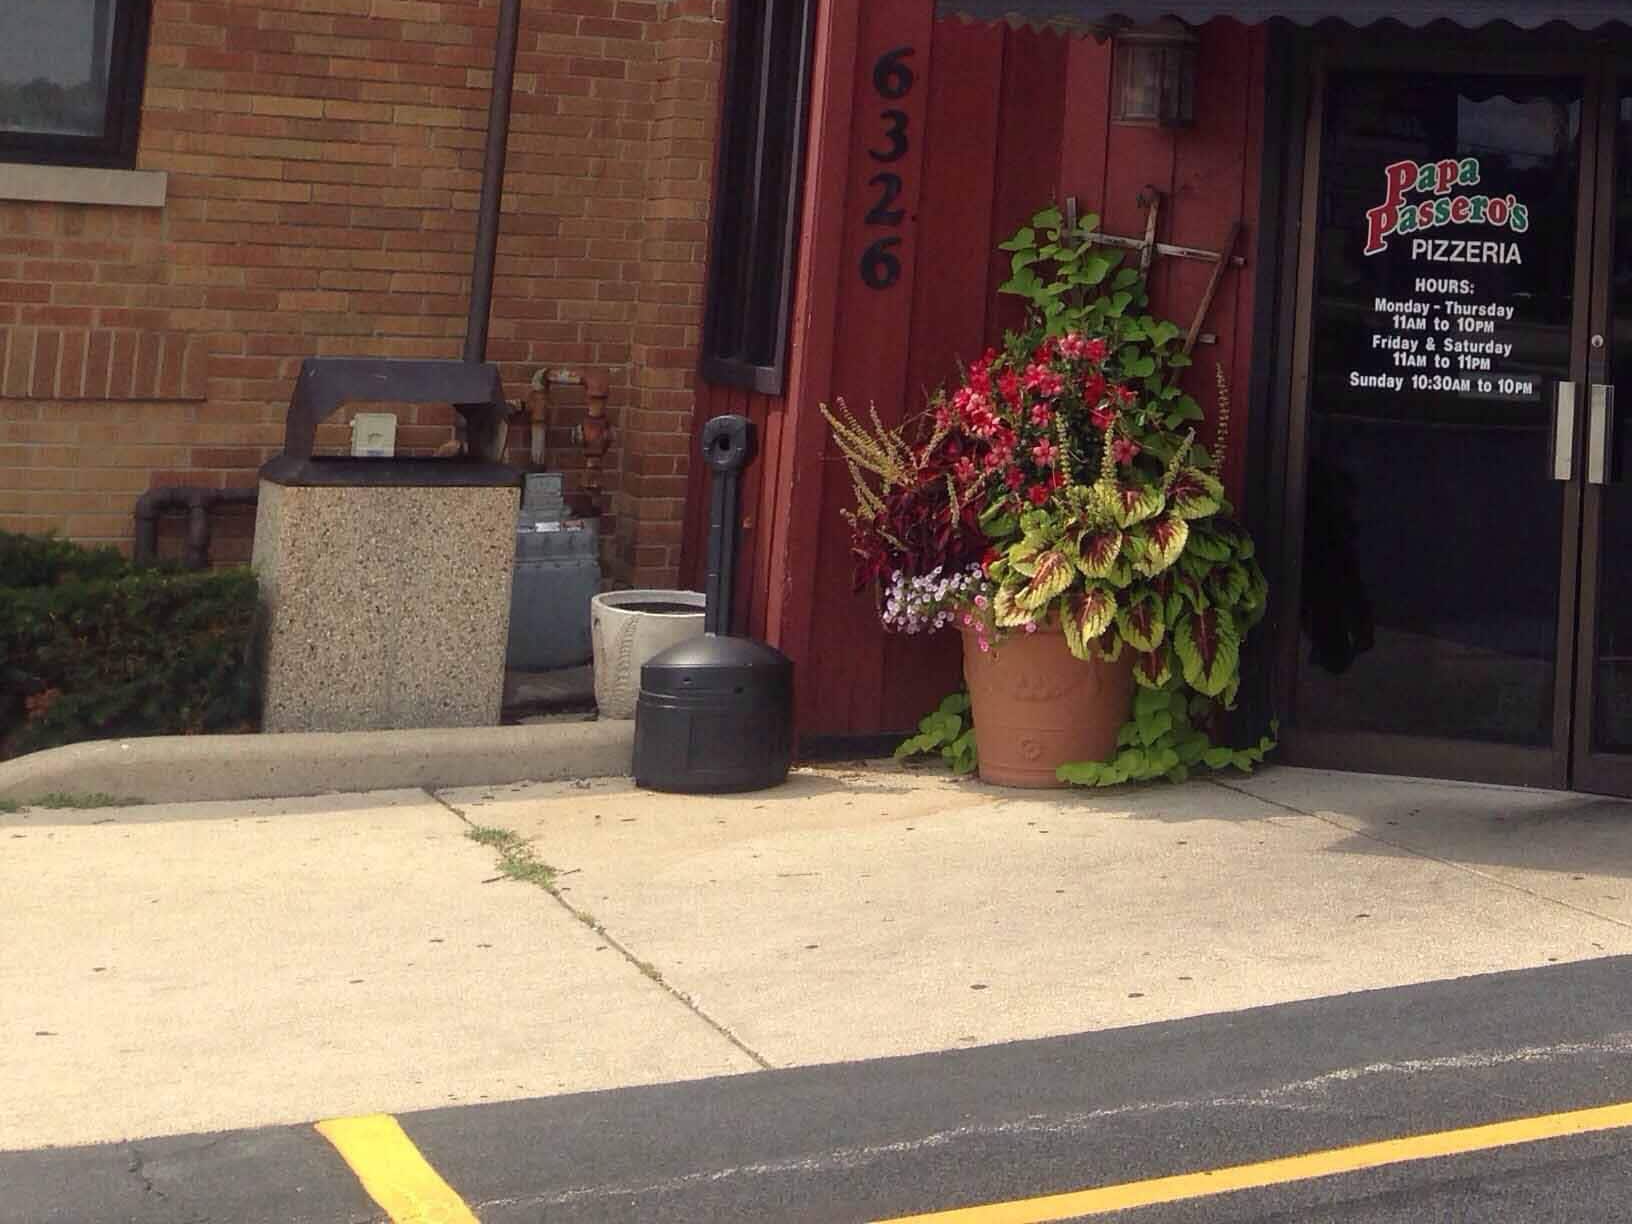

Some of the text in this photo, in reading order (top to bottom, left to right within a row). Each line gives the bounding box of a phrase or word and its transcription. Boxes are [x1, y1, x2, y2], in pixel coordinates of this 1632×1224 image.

[859, 45, 916, 291] 6326
[1385, 157, 1481, 208] Papa
[1364, 194, 1529, 256] Passero's
[1411, 238, 1522, 265] PIZZERIA
[1415, 277, 1475, 295] HOURS:
[1374, 297, 1430, 316] Monday
[1445, 300, 1514, 320] Thursday
[1392, 314, 1495, 333] 11AM to 10PM
[1372, 334, 1513, 357] Friday & Saturday
[1393, 352, 1491, 371] 11AM to 11PM
[1350, 372, 1533, 395] Sunday 10:30AM to 10PM
